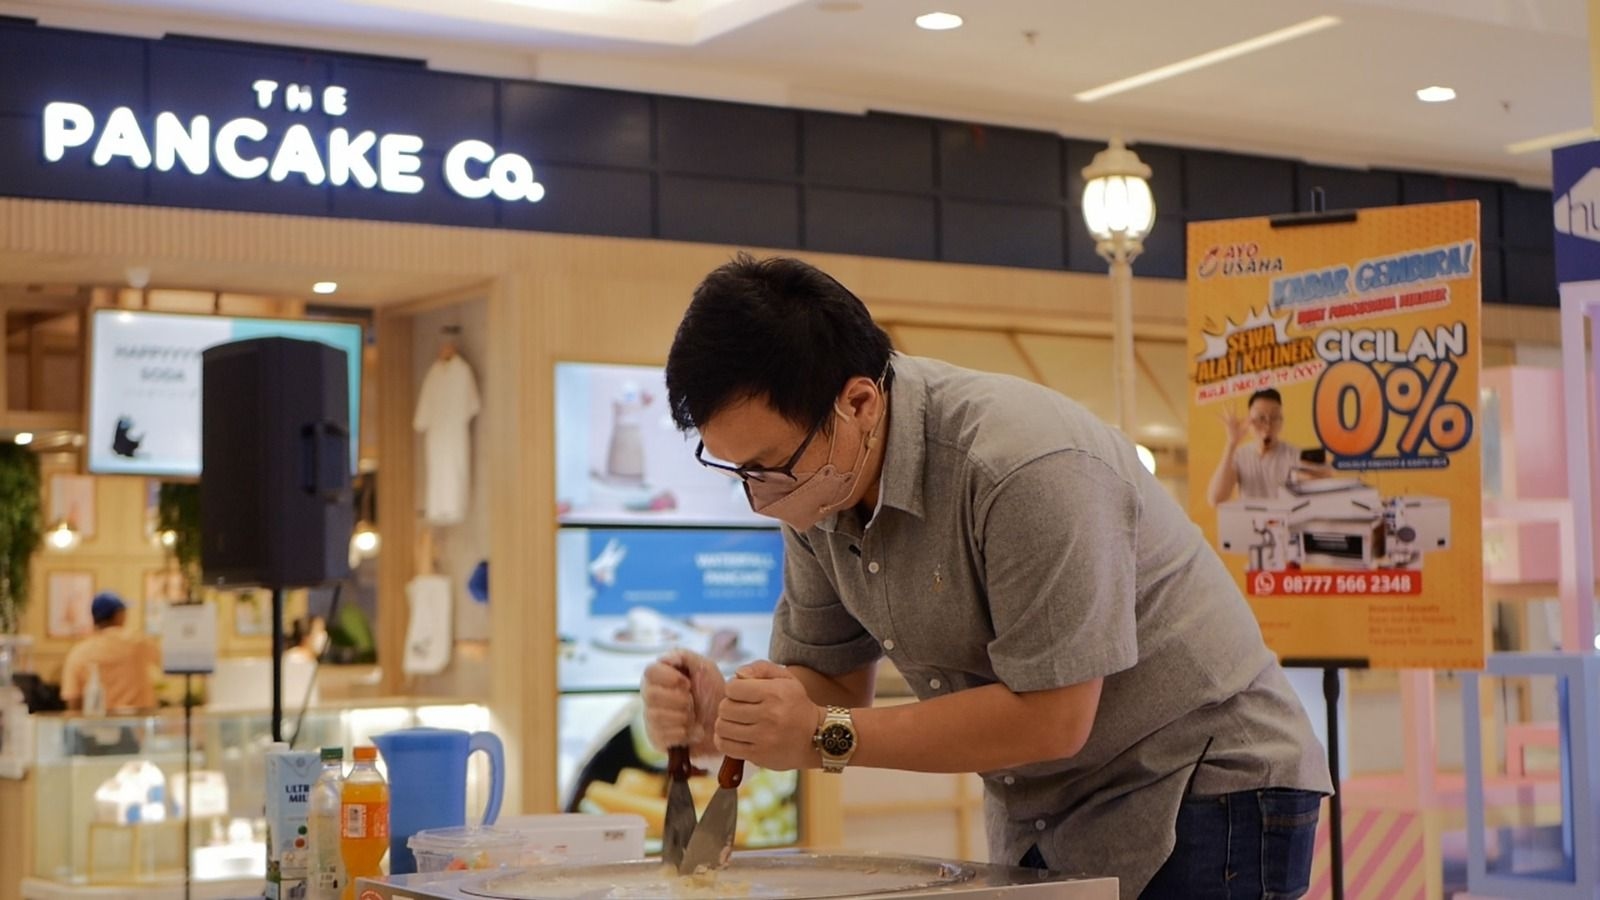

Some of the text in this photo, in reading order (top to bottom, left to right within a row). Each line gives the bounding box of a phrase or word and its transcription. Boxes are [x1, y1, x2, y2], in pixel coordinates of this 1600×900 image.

[252, 79, 348, 116] THE
[43, 101, 545, 203] PANCAKE Co.
[1223, 243, 1259, 258] AYO
[1222, 257, 1284, 275] USAHA
[1273, 267, 1350, 308] KABAR
[1355, 243, 1474, 293] GEMBIRA!
[1226, 324, 1277, 350] SEWA
[1315, 322, 1466, 363] CICILAN
[1196, 353, 1238, 383] ALAT
[1240, 336, 1316, 374] KULINER
[140, 366, 186, 383] SODA
[1313, 360, 1474, 456] 0%
[1283, 574, 1412, 593] 08777 566 2348
[285, 784, 310, 793] ULTR
[288, 794, 308, 802] MIL
